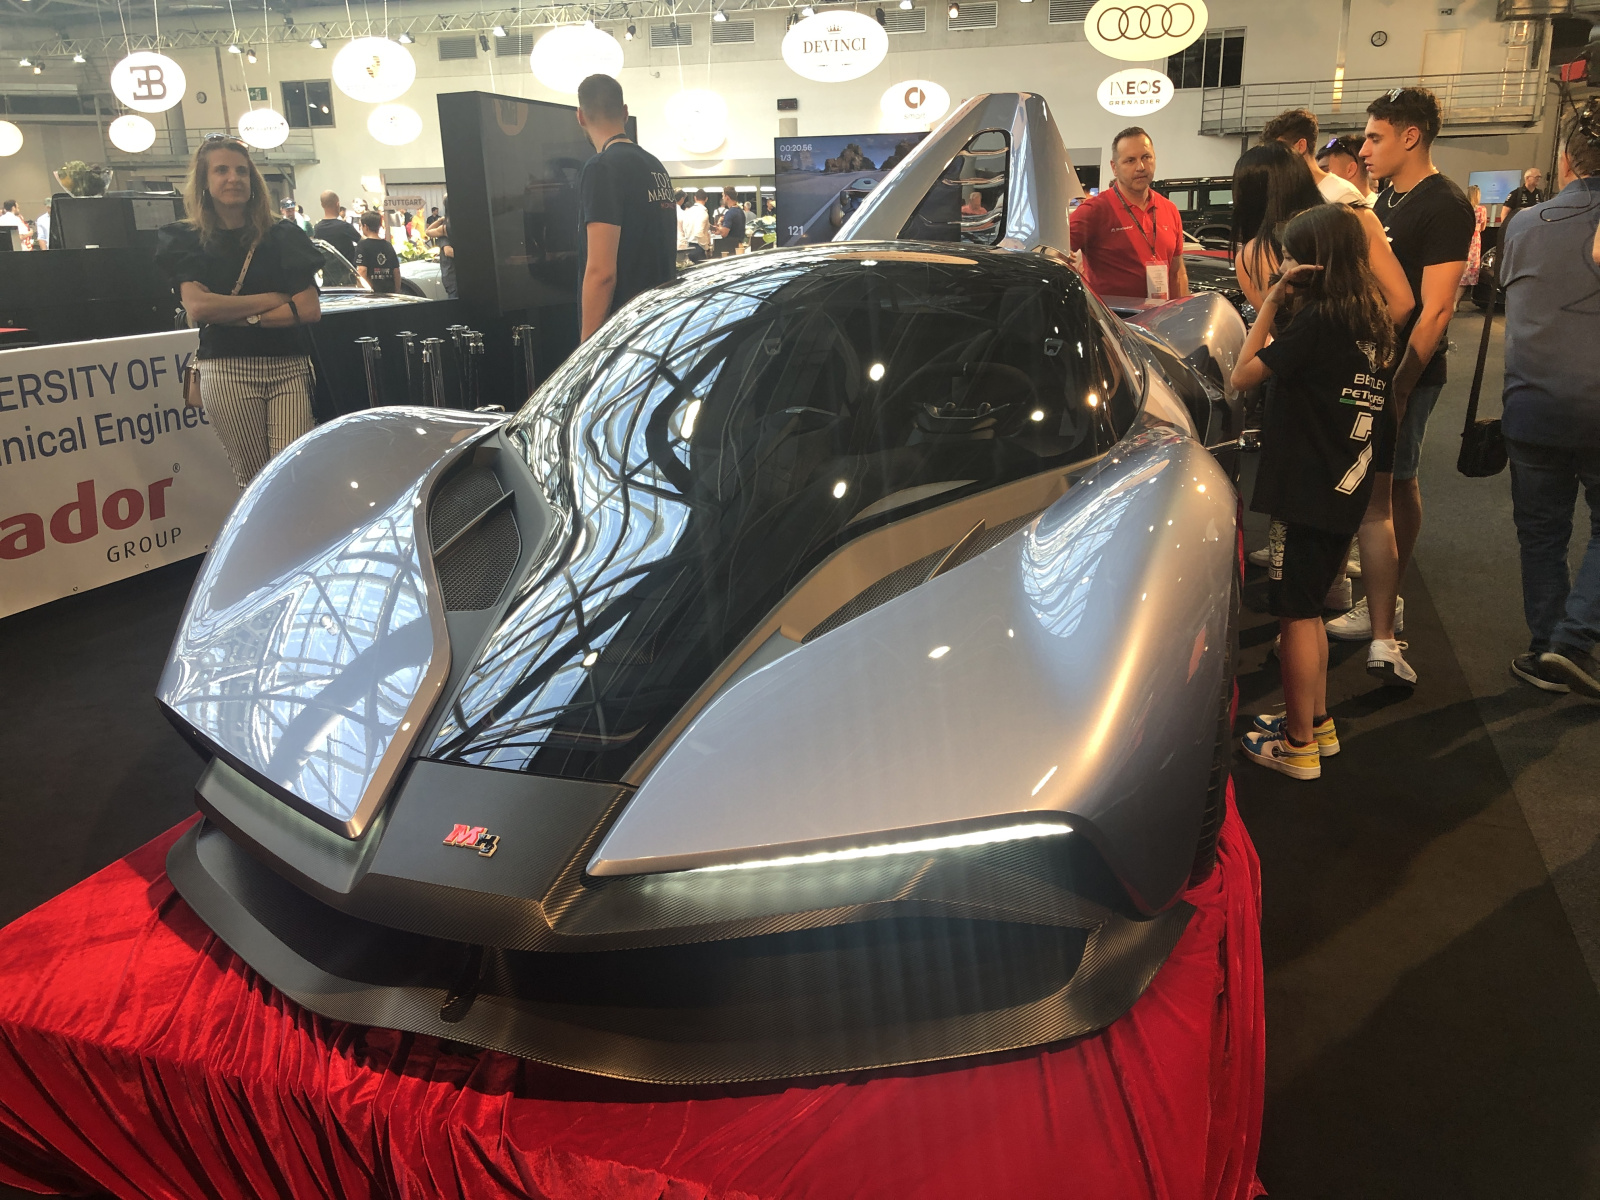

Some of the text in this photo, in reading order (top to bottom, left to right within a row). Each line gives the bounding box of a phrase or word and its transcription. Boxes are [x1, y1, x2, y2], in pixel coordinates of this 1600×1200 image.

[803, 37, 866, 54] DEVINCI
[1110, 79, 1161, 96] INEOS
[779, 143, 813, 152] 00:20.56
[780, 154, 791, 162] 1/3
[384, 198, 422, 207] STUTTGART
[787, 225, 805, 236] 121
[127, 356, 168, 391] OF
[0, 416, 88, 466] nical
[106, 527, 182, 564] GROUP
